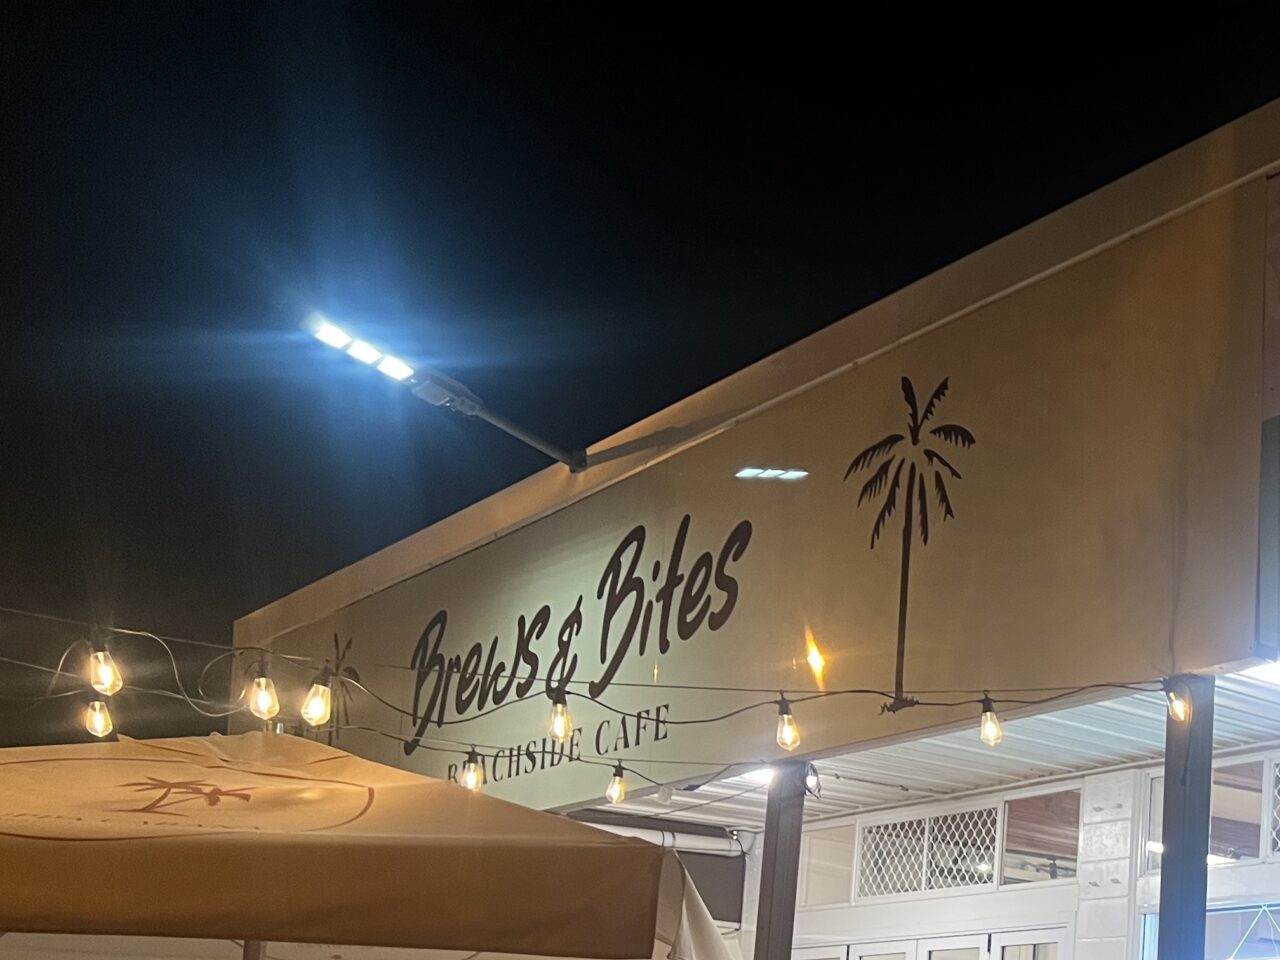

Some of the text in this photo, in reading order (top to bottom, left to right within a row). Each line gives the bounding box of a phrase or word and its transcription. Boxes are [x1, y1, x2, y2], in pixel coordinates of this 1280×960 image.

[404, 513, 753, 756] Brews & Bites
[447, 703, 670, 786] BACHSIDE CAFE
